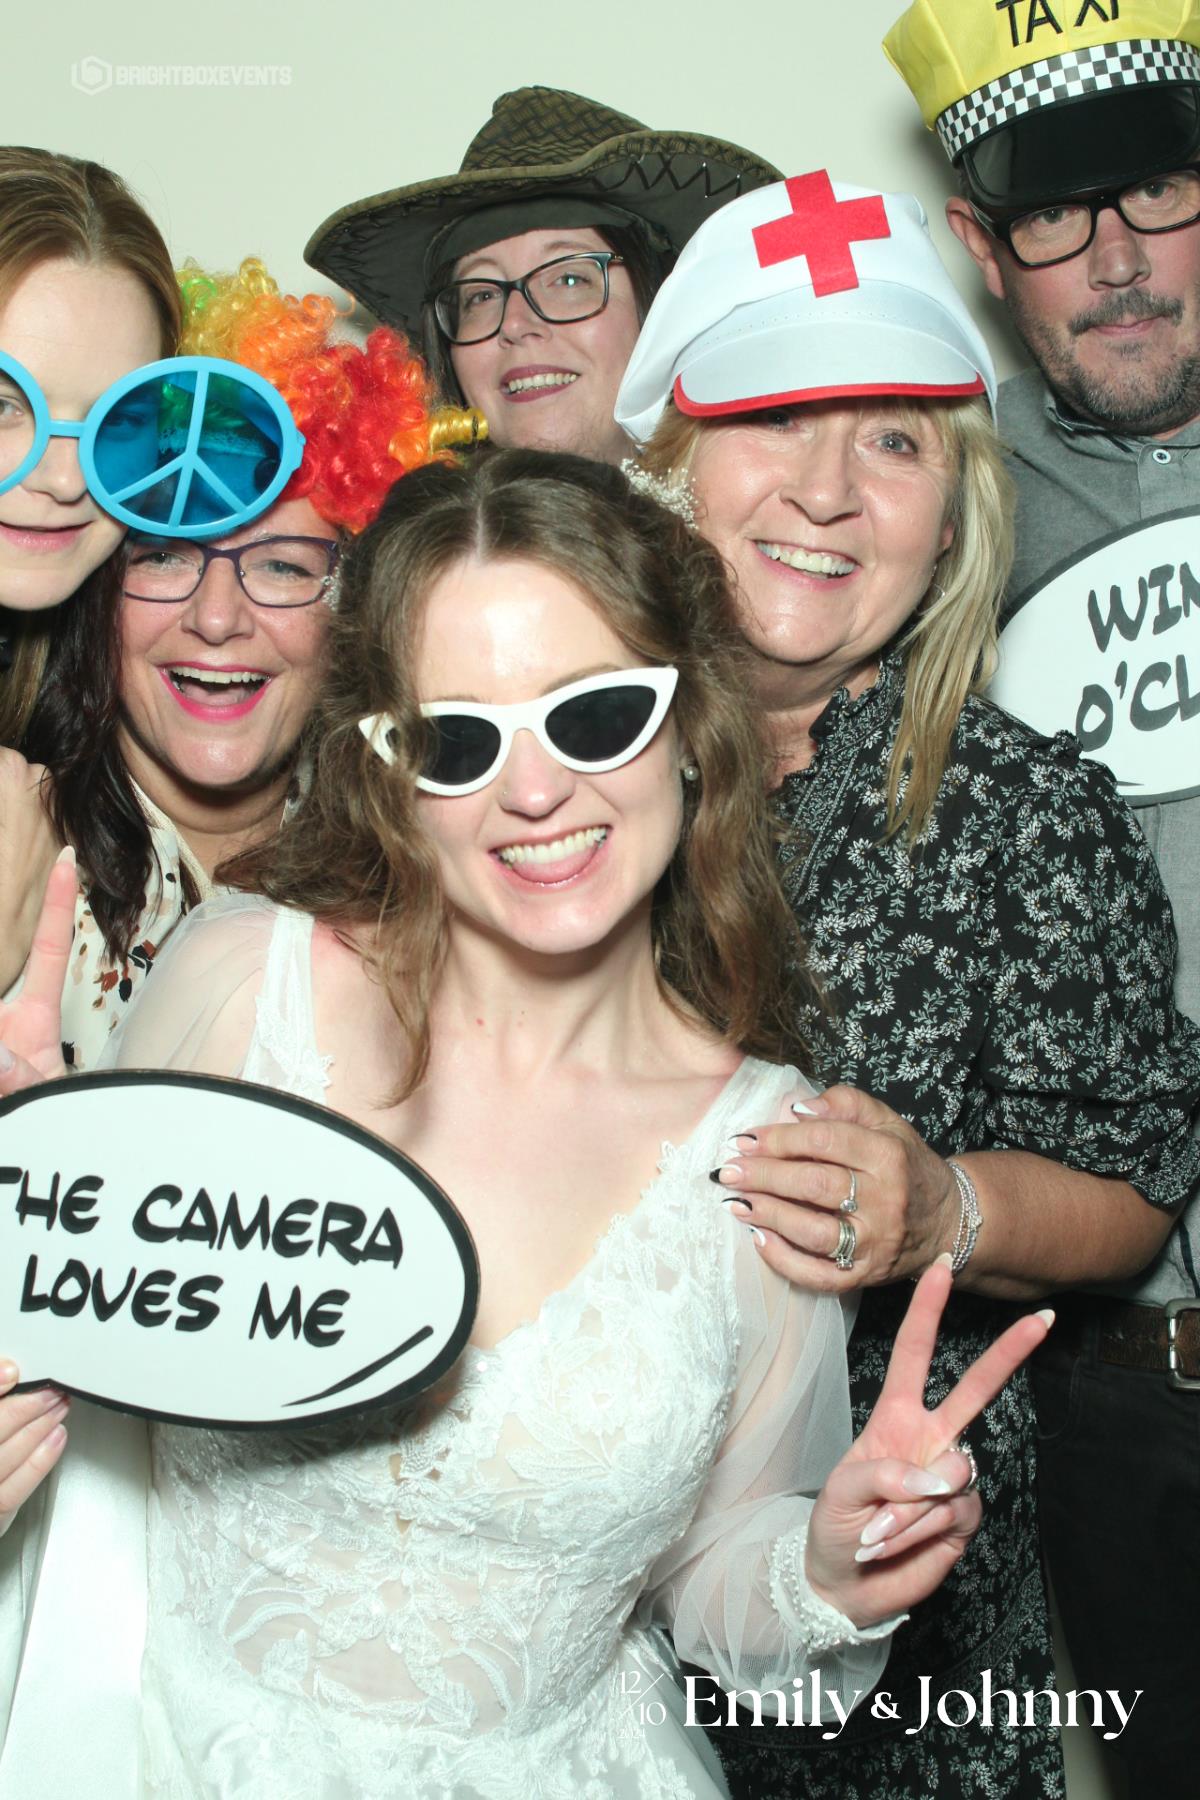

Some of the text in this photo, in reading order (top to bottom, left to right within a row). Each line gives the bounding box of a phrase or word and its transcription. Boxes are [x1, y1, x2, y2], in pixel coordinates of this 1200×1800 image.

[132, 1184, 403, 1270] CAMERA
[20, 1253, 351, 1348] LOVES ME
